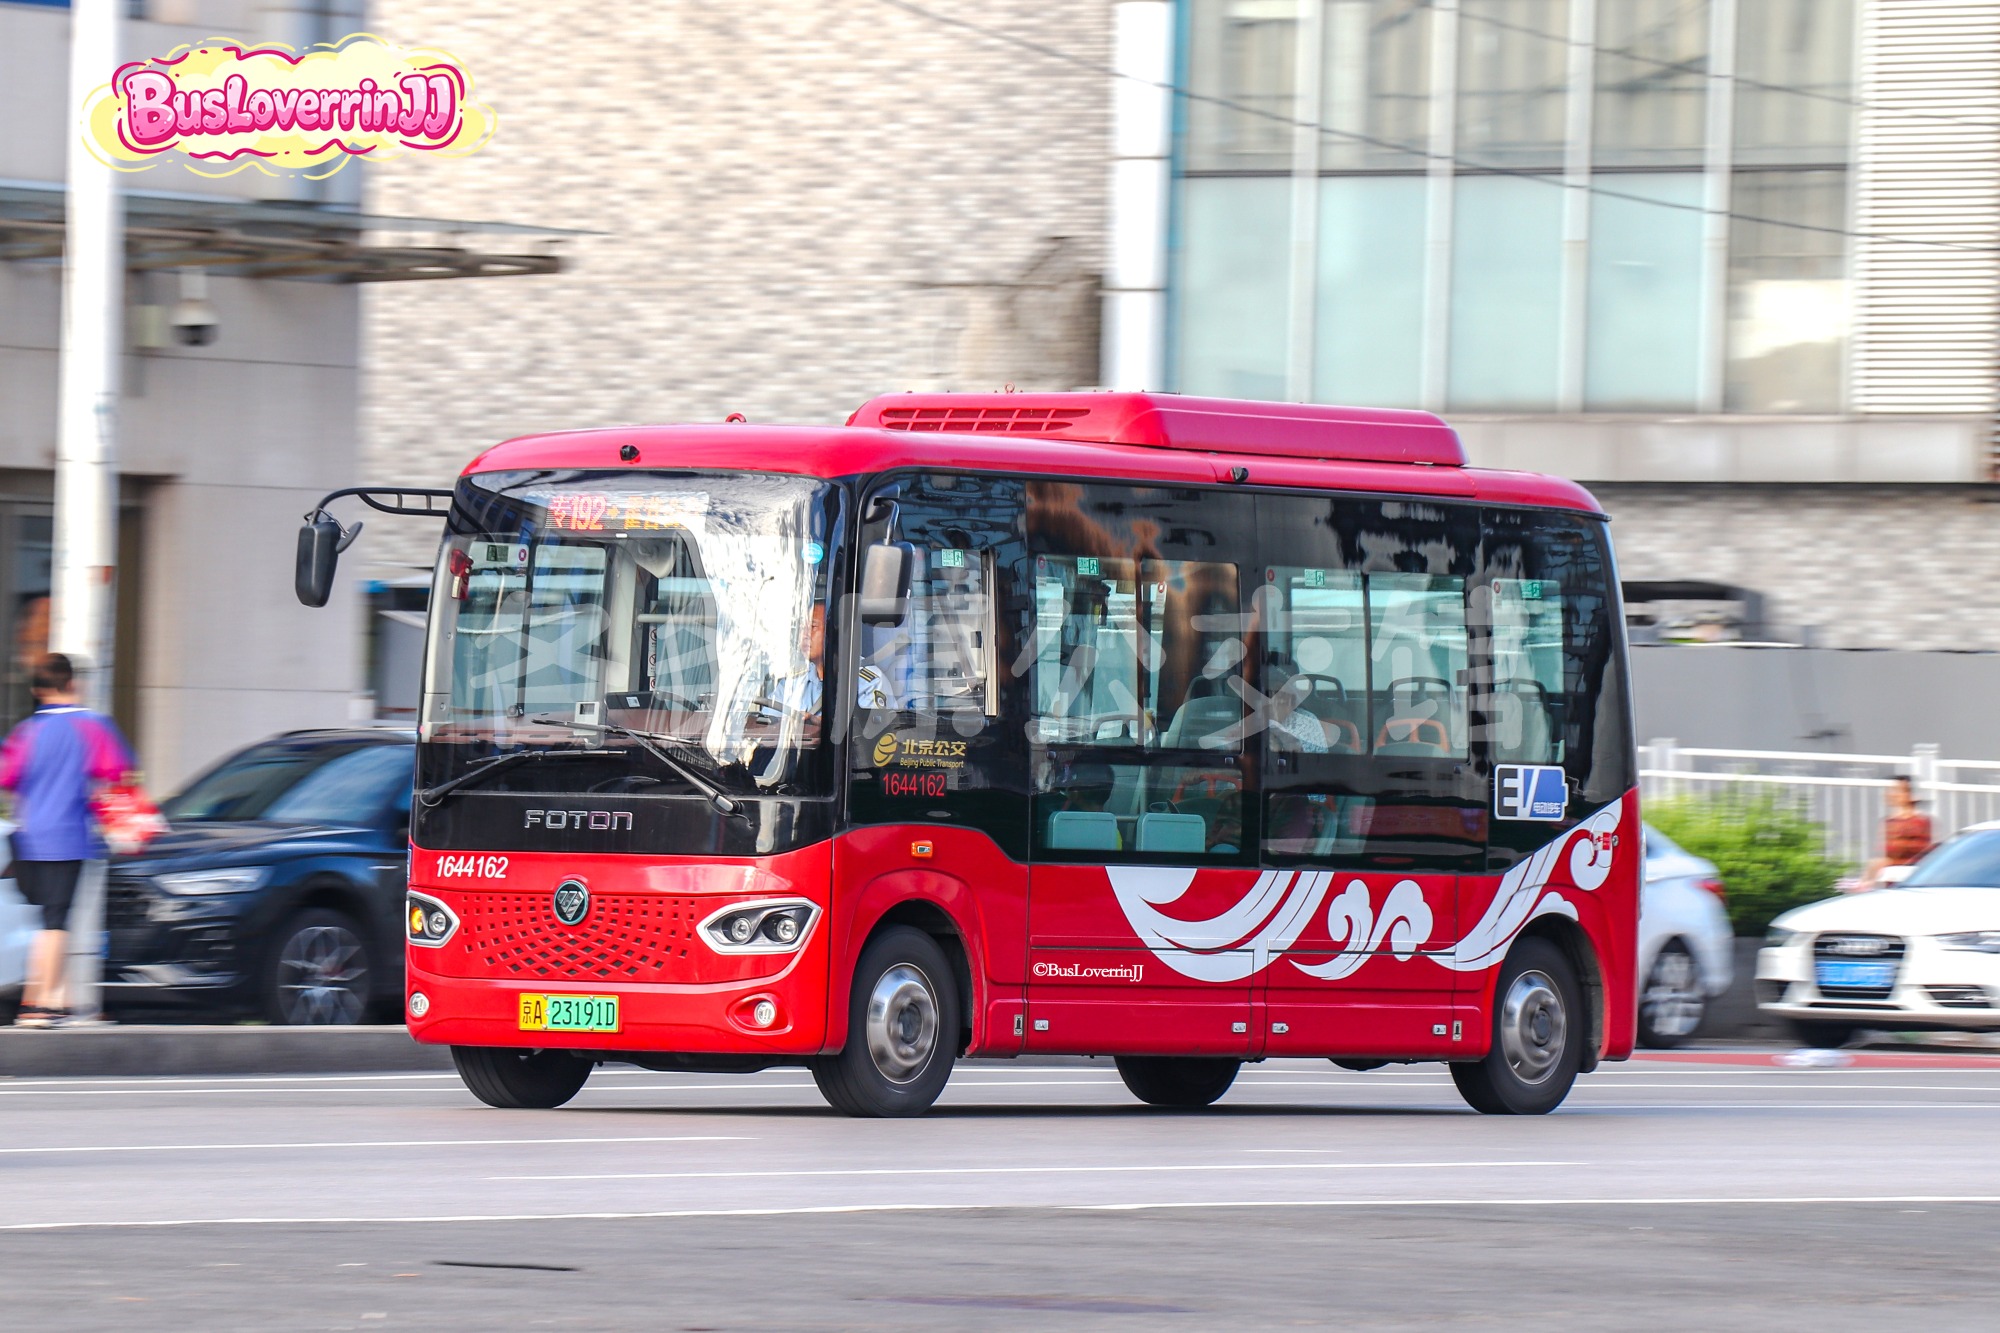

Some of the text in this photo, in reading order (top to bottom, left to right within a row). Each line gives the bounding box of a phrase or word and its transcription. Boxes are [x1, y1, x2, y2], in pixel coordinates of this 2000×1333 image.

[901, 739, 967, 757] 北京公交
[900, 757, 964, 770] Beijing Public Transport
[882, 773, 945, 797] 1644162
[1498, 767, 1541, 817] EV
[524, 810, 633, 831] FOTON
[436, 855, 509, 879] 1644162
